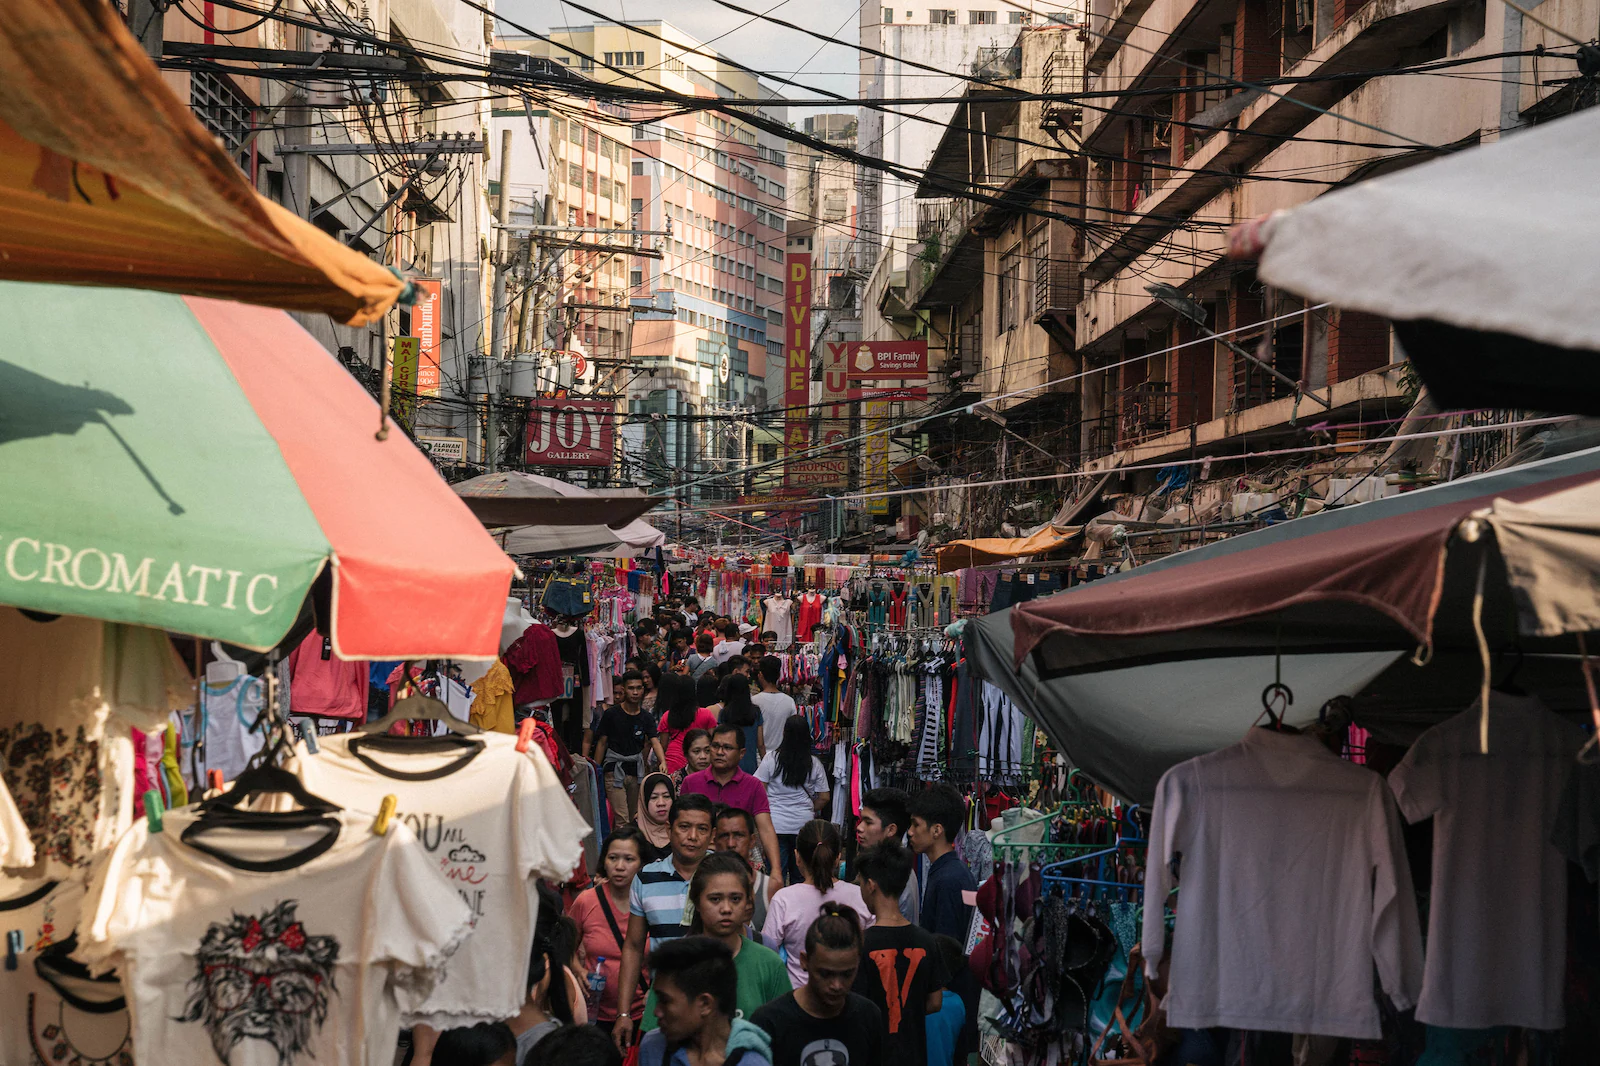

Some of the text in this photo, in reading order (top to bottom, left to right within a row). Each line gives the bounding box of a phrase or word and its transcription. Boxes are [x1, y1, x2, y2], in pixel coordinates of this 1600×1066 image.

[790, 263, 807, 390] DIVINE
[401, 341, 411, 363] MAI
[877, 351, 920, 362] BPI Family
[879, 362, 902, 370] Savings
[529, 405, 611, 453] JOY
[547, 451, 592, 460] GALLERY
[792, 461, 845, 472] SHOPPING
[798, 474, 840, 484] CENTER
[0, 535, 279, 616] CROMATIC
